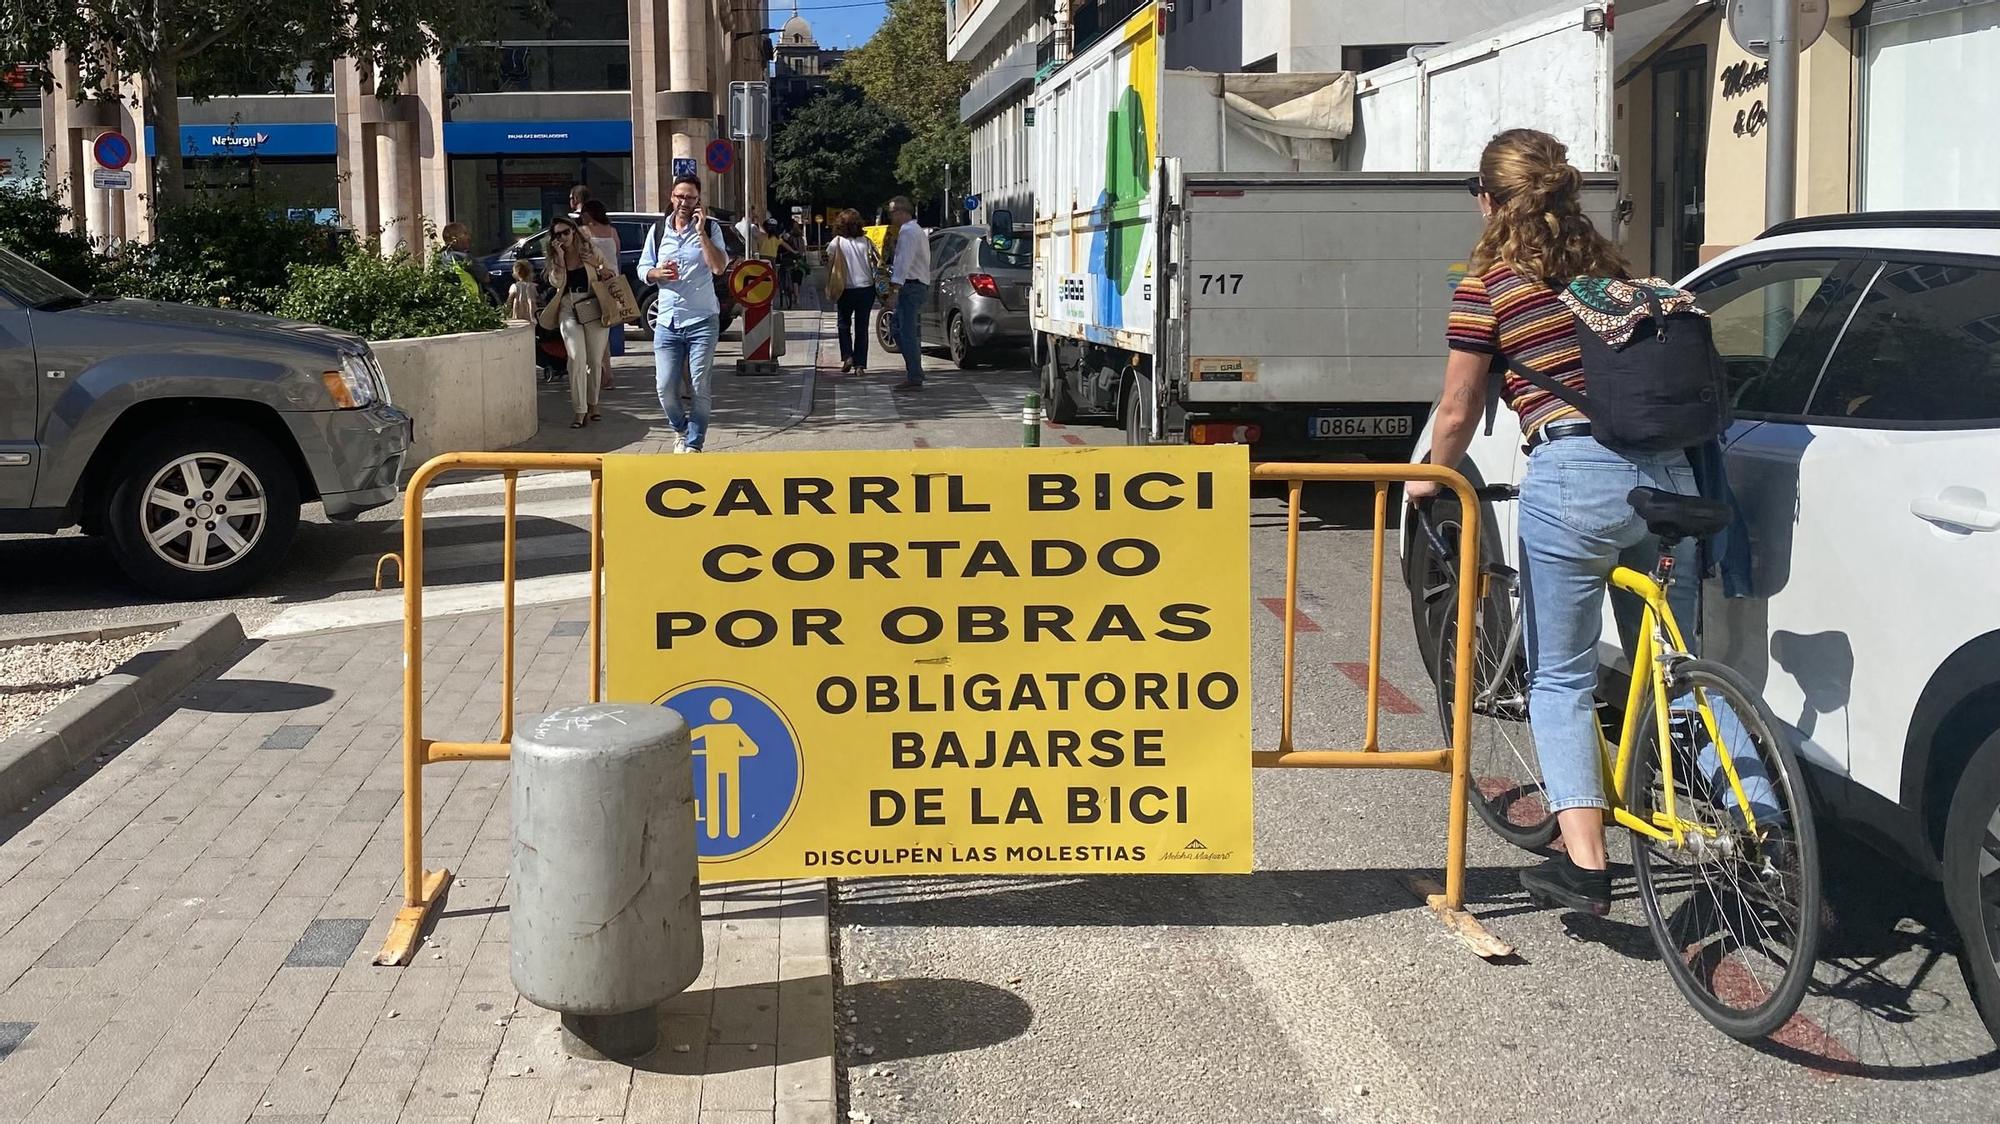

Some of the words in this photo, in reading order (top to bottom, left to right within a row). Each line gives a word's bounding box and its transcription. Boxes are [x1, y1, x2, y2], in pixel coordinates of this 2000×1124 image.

[1199, 274, 1244, 295] 717
[1320, 419, 1366, 435] 0864
[1373, 418, 1408, 434] KGB
[645, 473, 991, 518] CARRIL
[1028, 472, 1213, 512] BICI
[702, 538, 1160, 583] CORTADO
[656, 608, 845, 650] POR
[881, 603, 1212, 644] OBRAS
[816, 671, 1239, 714] OBLIGATORIO
[892, 729, 1166, 770] BAJARSE
[869, 788, 946, 827] DE
[971, 787, 1044, 825] LA
[1067, 786, 1188, 824] BICI
[952, 847, 997, 862] LAS
[1006, 845, 1146, 862] MOLESTIAS
